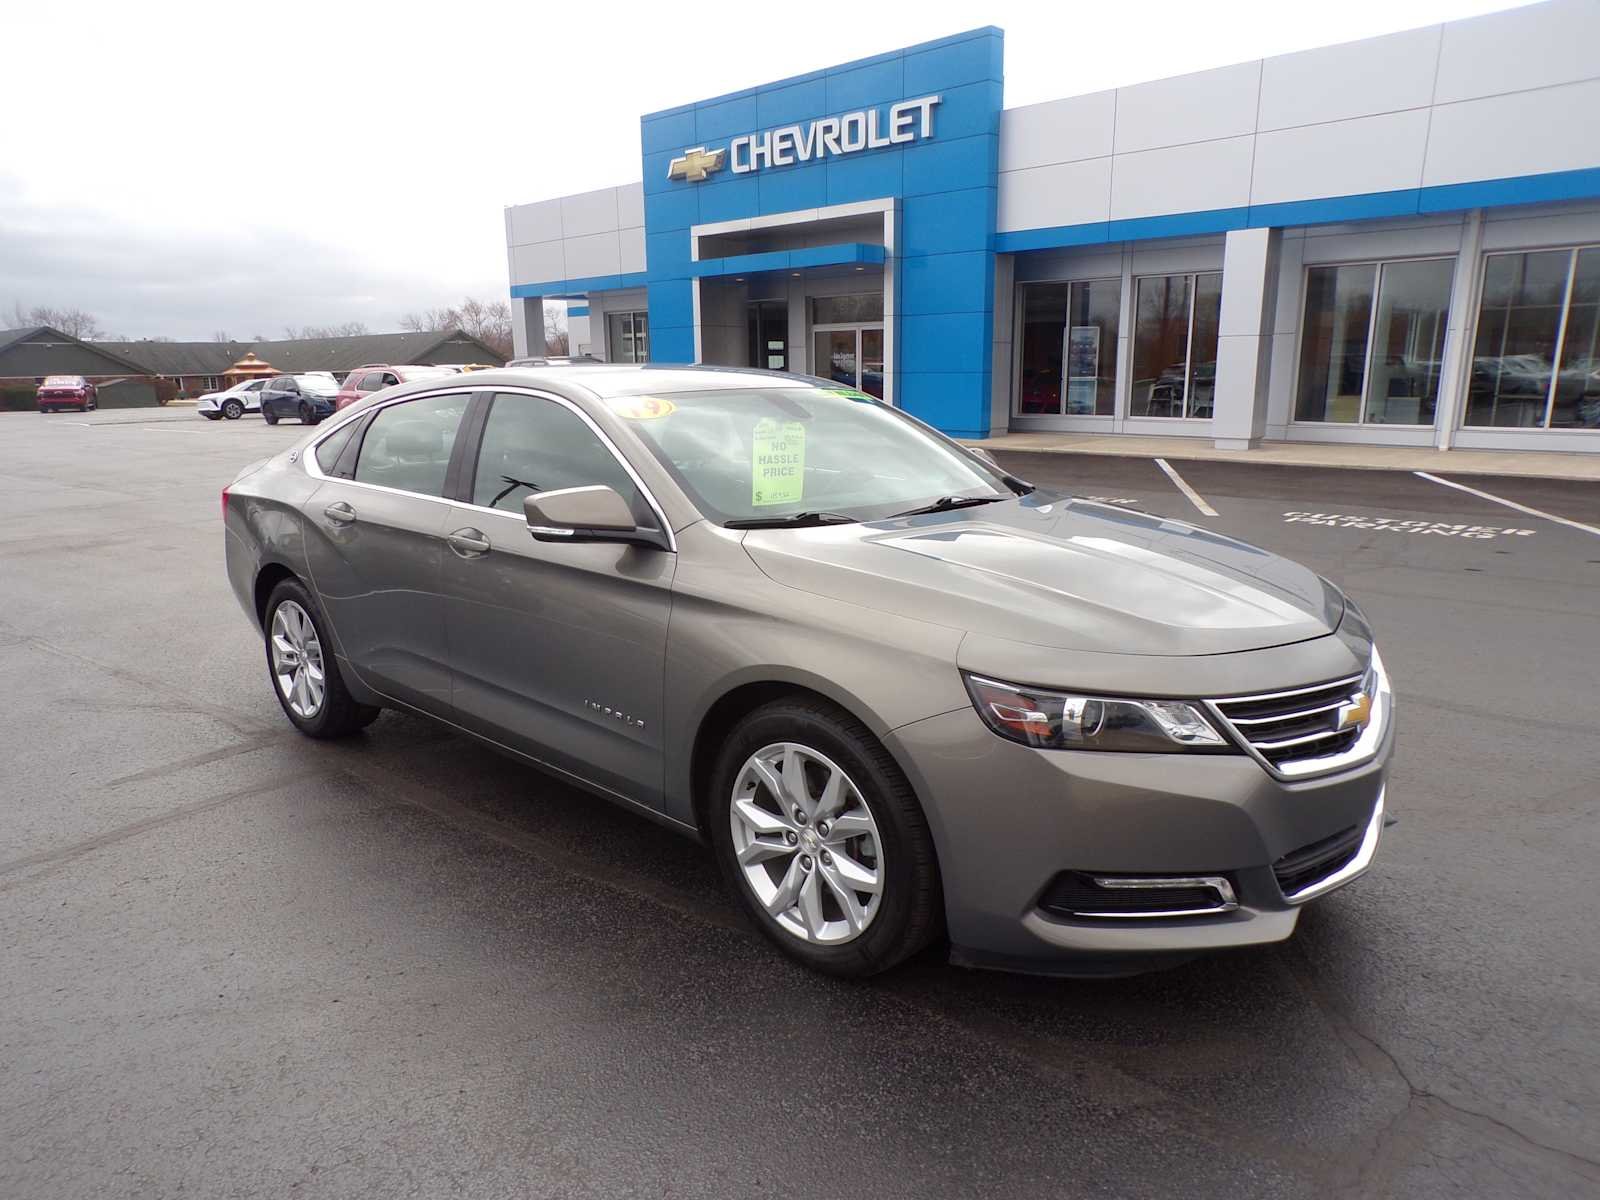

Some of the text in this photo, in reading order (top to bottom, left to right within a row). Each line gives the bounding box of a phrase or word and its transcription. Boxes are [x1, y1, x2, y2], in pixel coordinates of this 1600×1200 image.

[731, 95, 942, 174] CHEVROLET
[771, 441, 788, 452] NO
[758, 454, 800, 465] HASSLE
[762, 466, 796, 478] PRICE
[755, 491, 763, 502] $
[1282, 511, 1537, 536] CUSTOMER
[1284, 517, 1497, 539] PARKING
[584, 699, 645, 728] IMPALA
